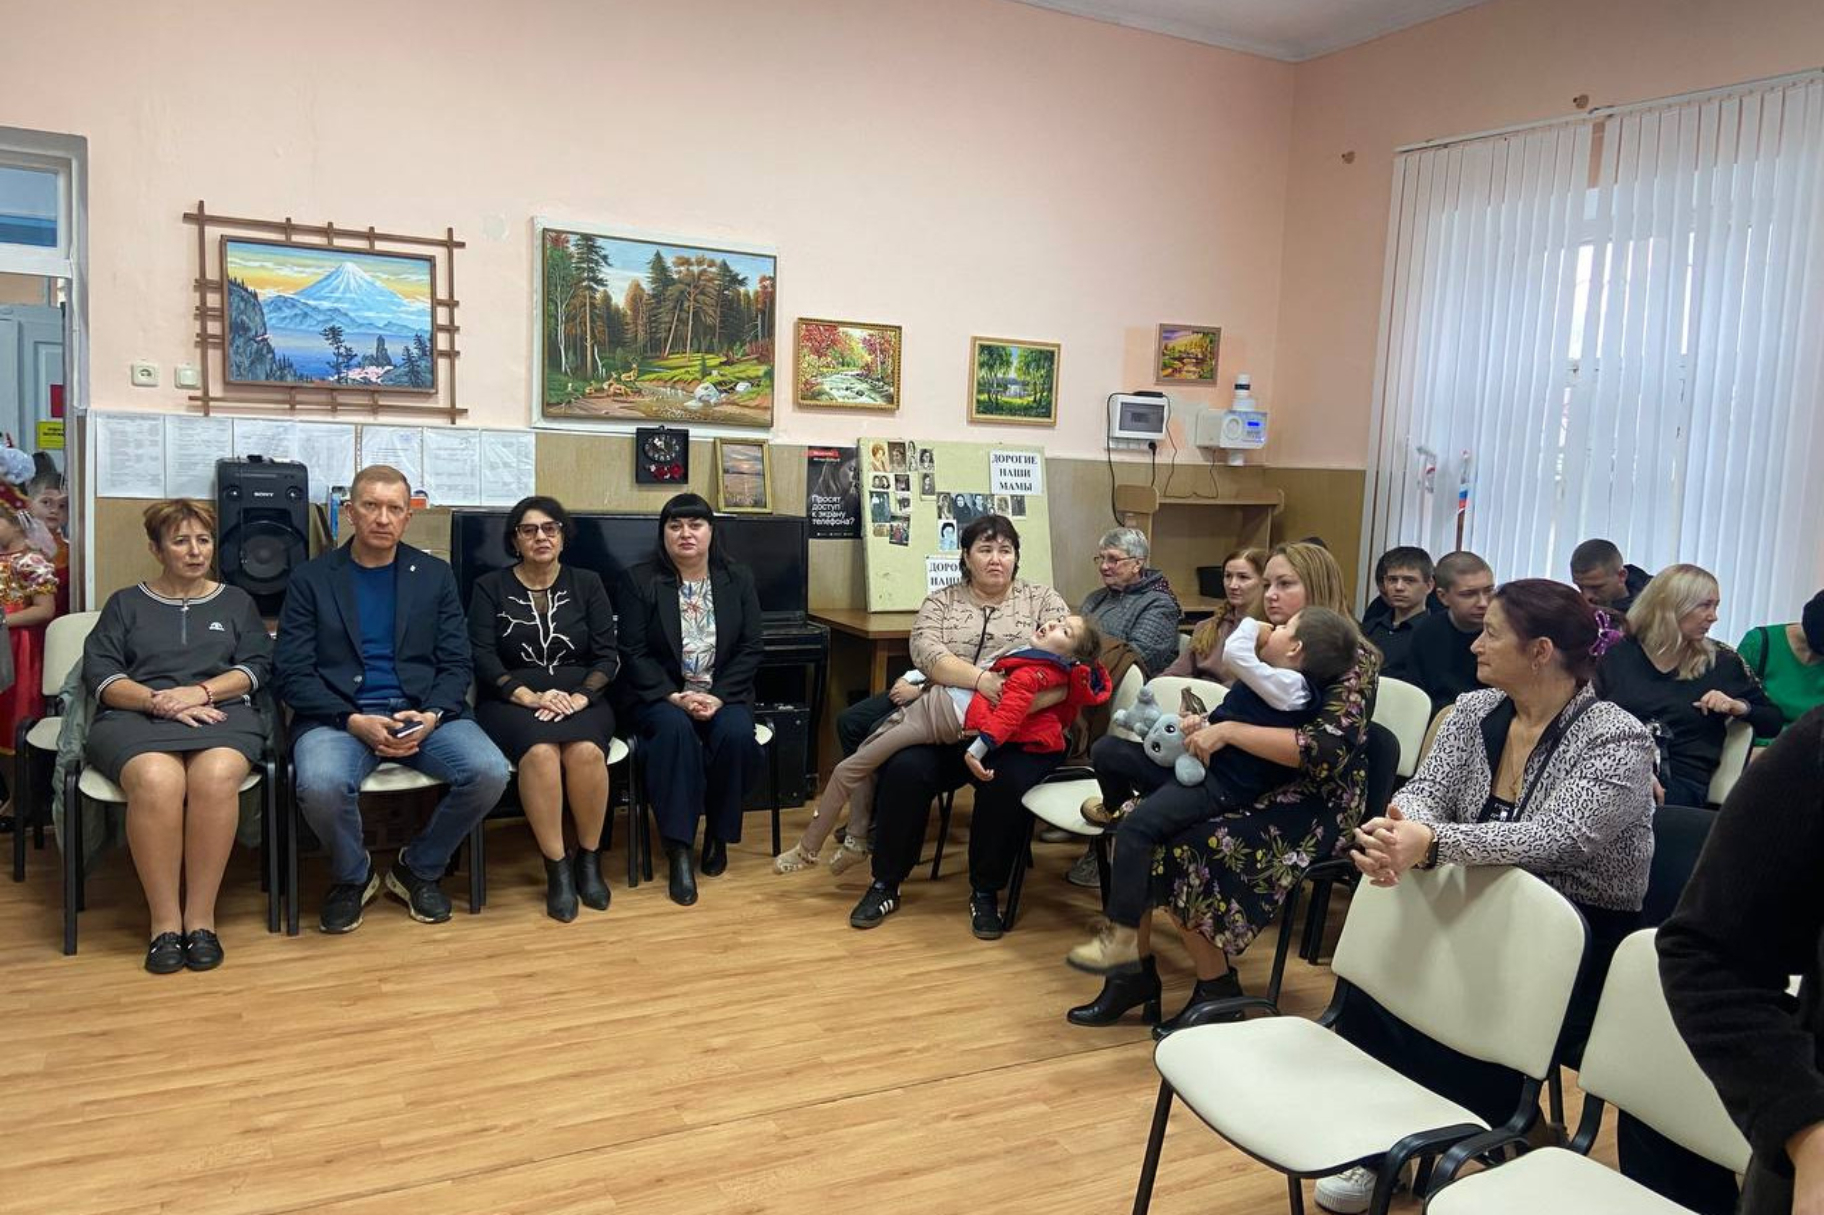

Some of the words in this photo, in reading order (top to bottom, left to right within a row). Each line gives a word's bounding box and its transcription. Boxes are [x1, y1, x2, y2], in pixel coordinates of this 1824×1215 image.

[992, 454, 1038, 465] ДОРОГИЕ
[999, 468, 1031, 477] НАШИ
[999, 481, 1032, 491] МАМЫ
[811, 503, 840, 512] доступ
[818, 511, 846, 519] экрану
[811, 517, 855, 527] телефона?
[929, 562, 962, 572] ДОРО
